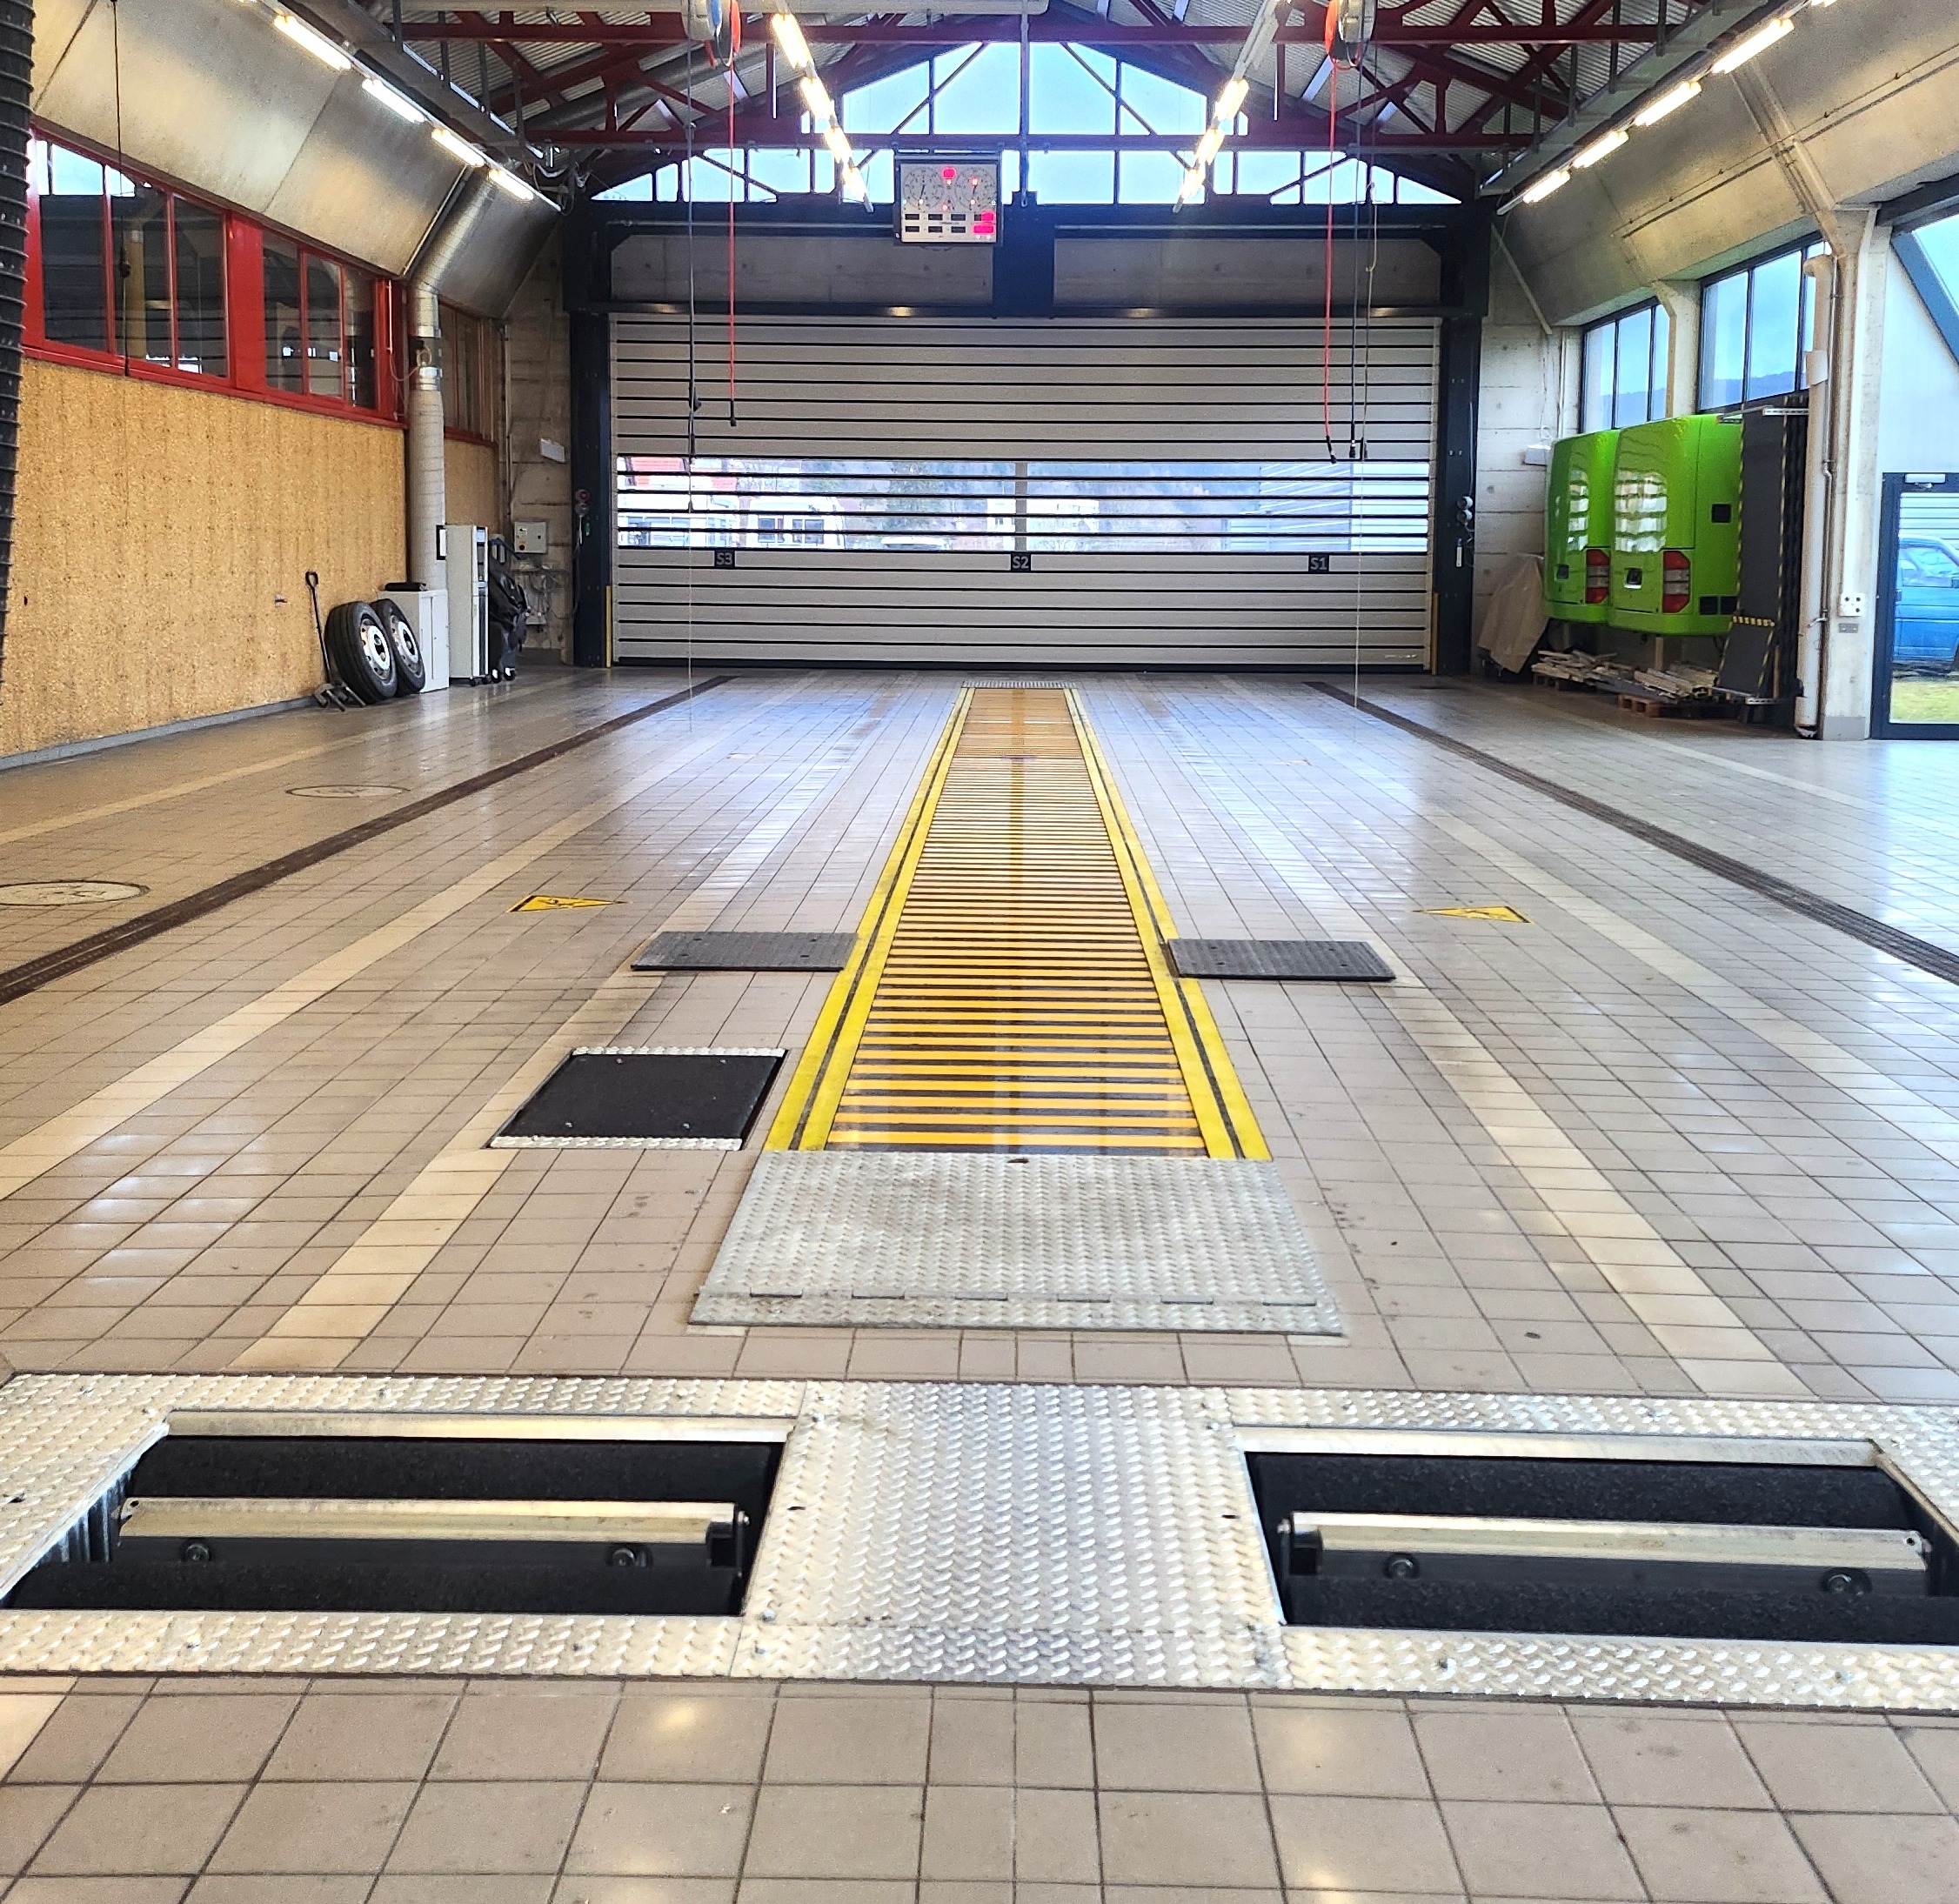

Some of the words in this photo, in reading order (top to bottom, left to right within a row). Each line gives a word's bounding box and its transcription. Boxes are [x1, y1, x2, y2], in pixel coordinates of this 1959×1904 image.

[716, 552, 733, 565] S3
[1012, 556, 1029, 569] S2
[1310, 557, 1327, 571] S1
